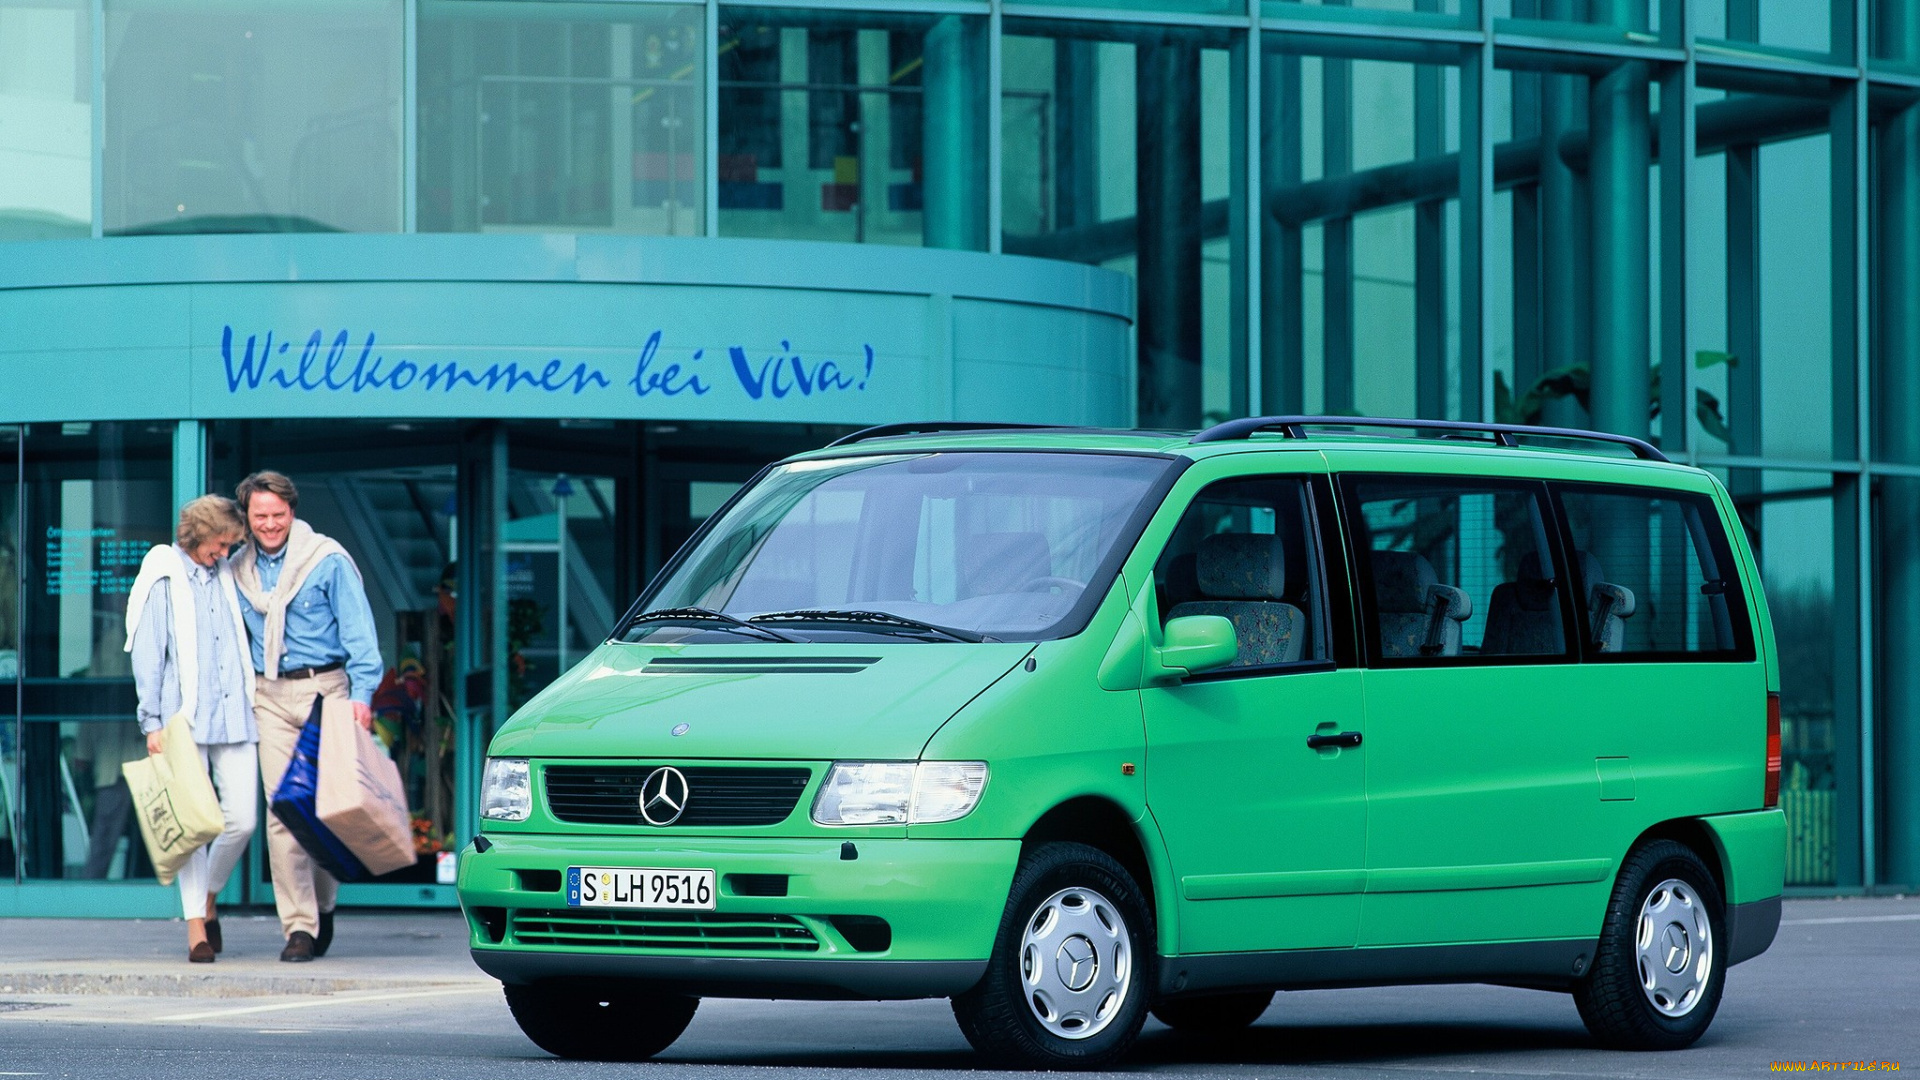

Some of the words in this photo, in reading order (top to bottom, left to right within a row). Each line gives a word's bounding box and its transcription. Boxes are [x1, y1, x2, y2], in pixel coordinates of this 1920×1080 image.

[221, 325, 611, 395] Willkommen
[629, 330, 711, 397] bei
[728, 339, 876, 401] Viva!
[571, 889, 578, 899] D
[583, 873, 597, 902] S
[614, 874, 644, 903] LH
[651, 875, 710, 904] 9516
